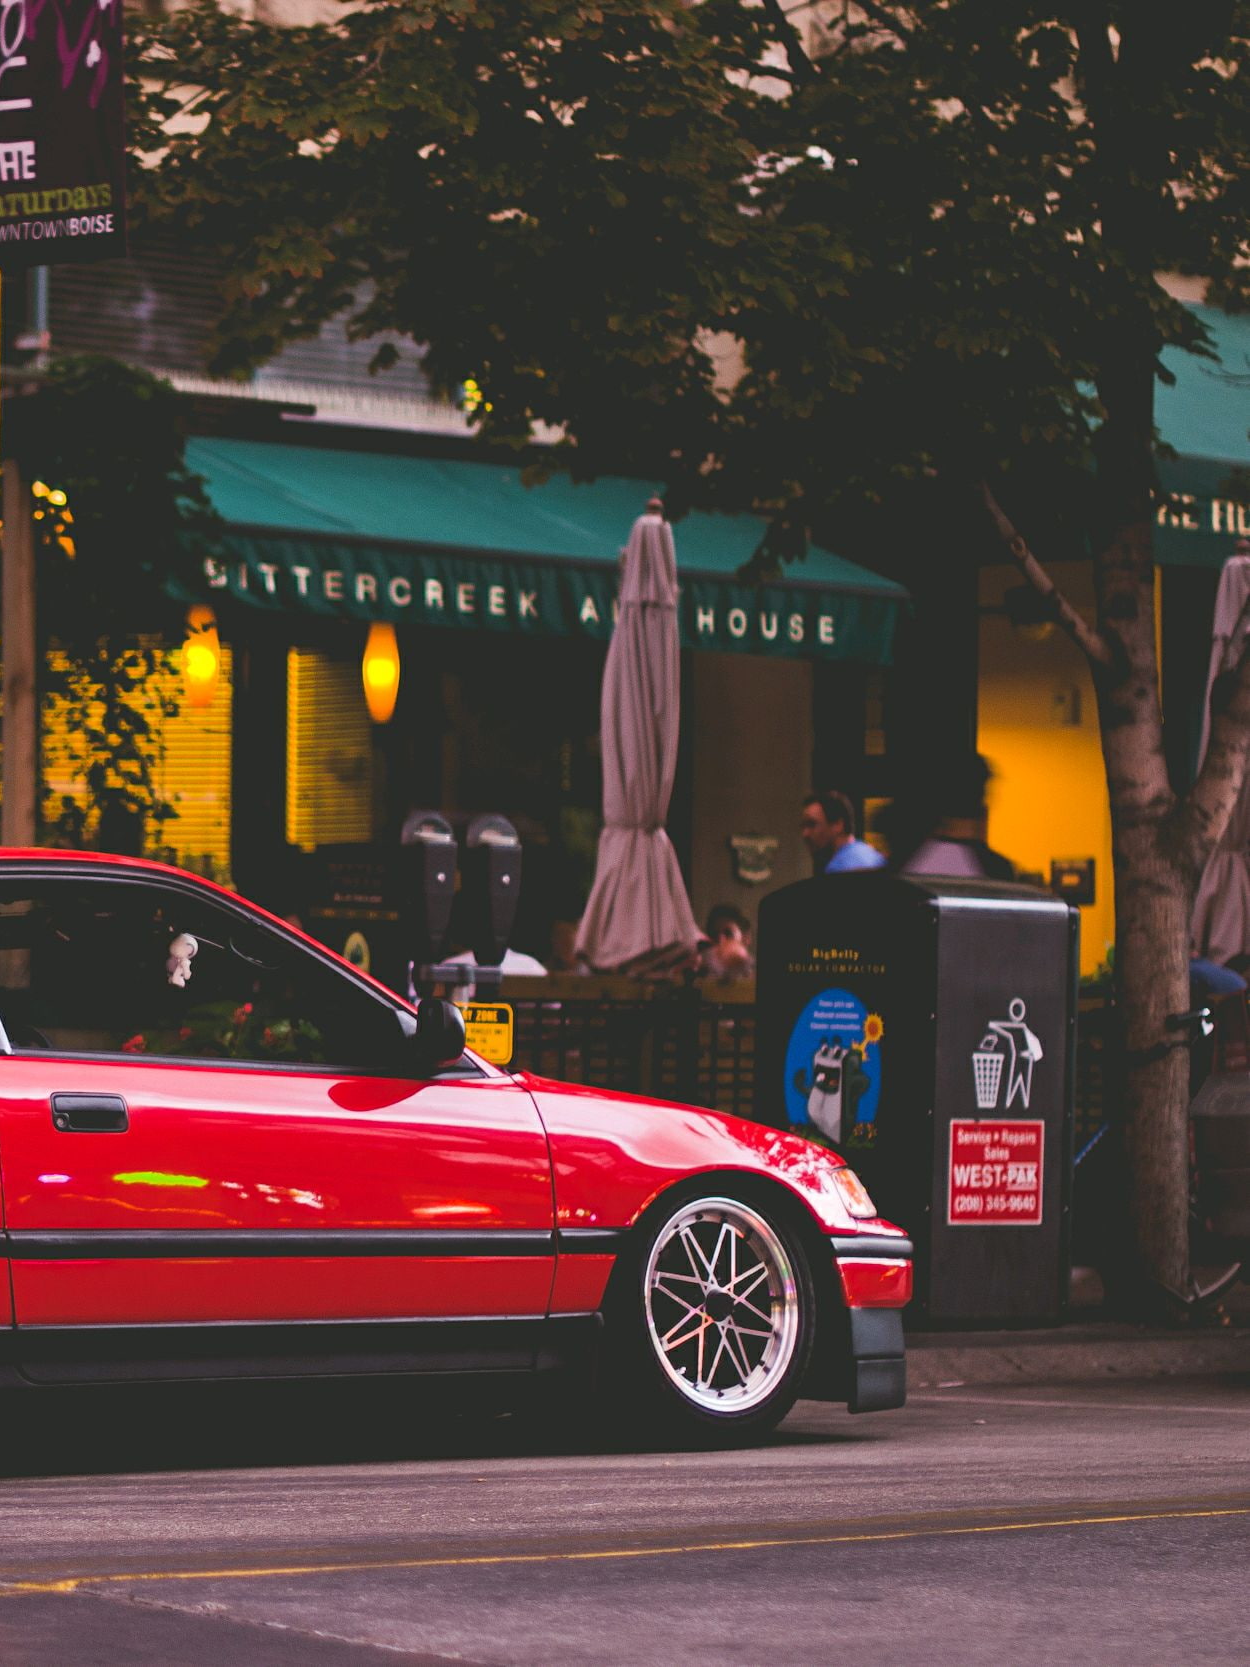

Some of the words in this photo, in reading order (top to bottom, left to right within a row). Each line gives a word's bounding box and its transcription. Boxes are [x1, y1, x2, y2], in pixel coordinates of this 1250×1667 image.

[697, 606, 835, 645] HOUSE
[957, 1128, 992, 1145] Service
[1001, 1128, 1037, 1146] Repairs
[984, 1145, 1010, 1161] Sales
